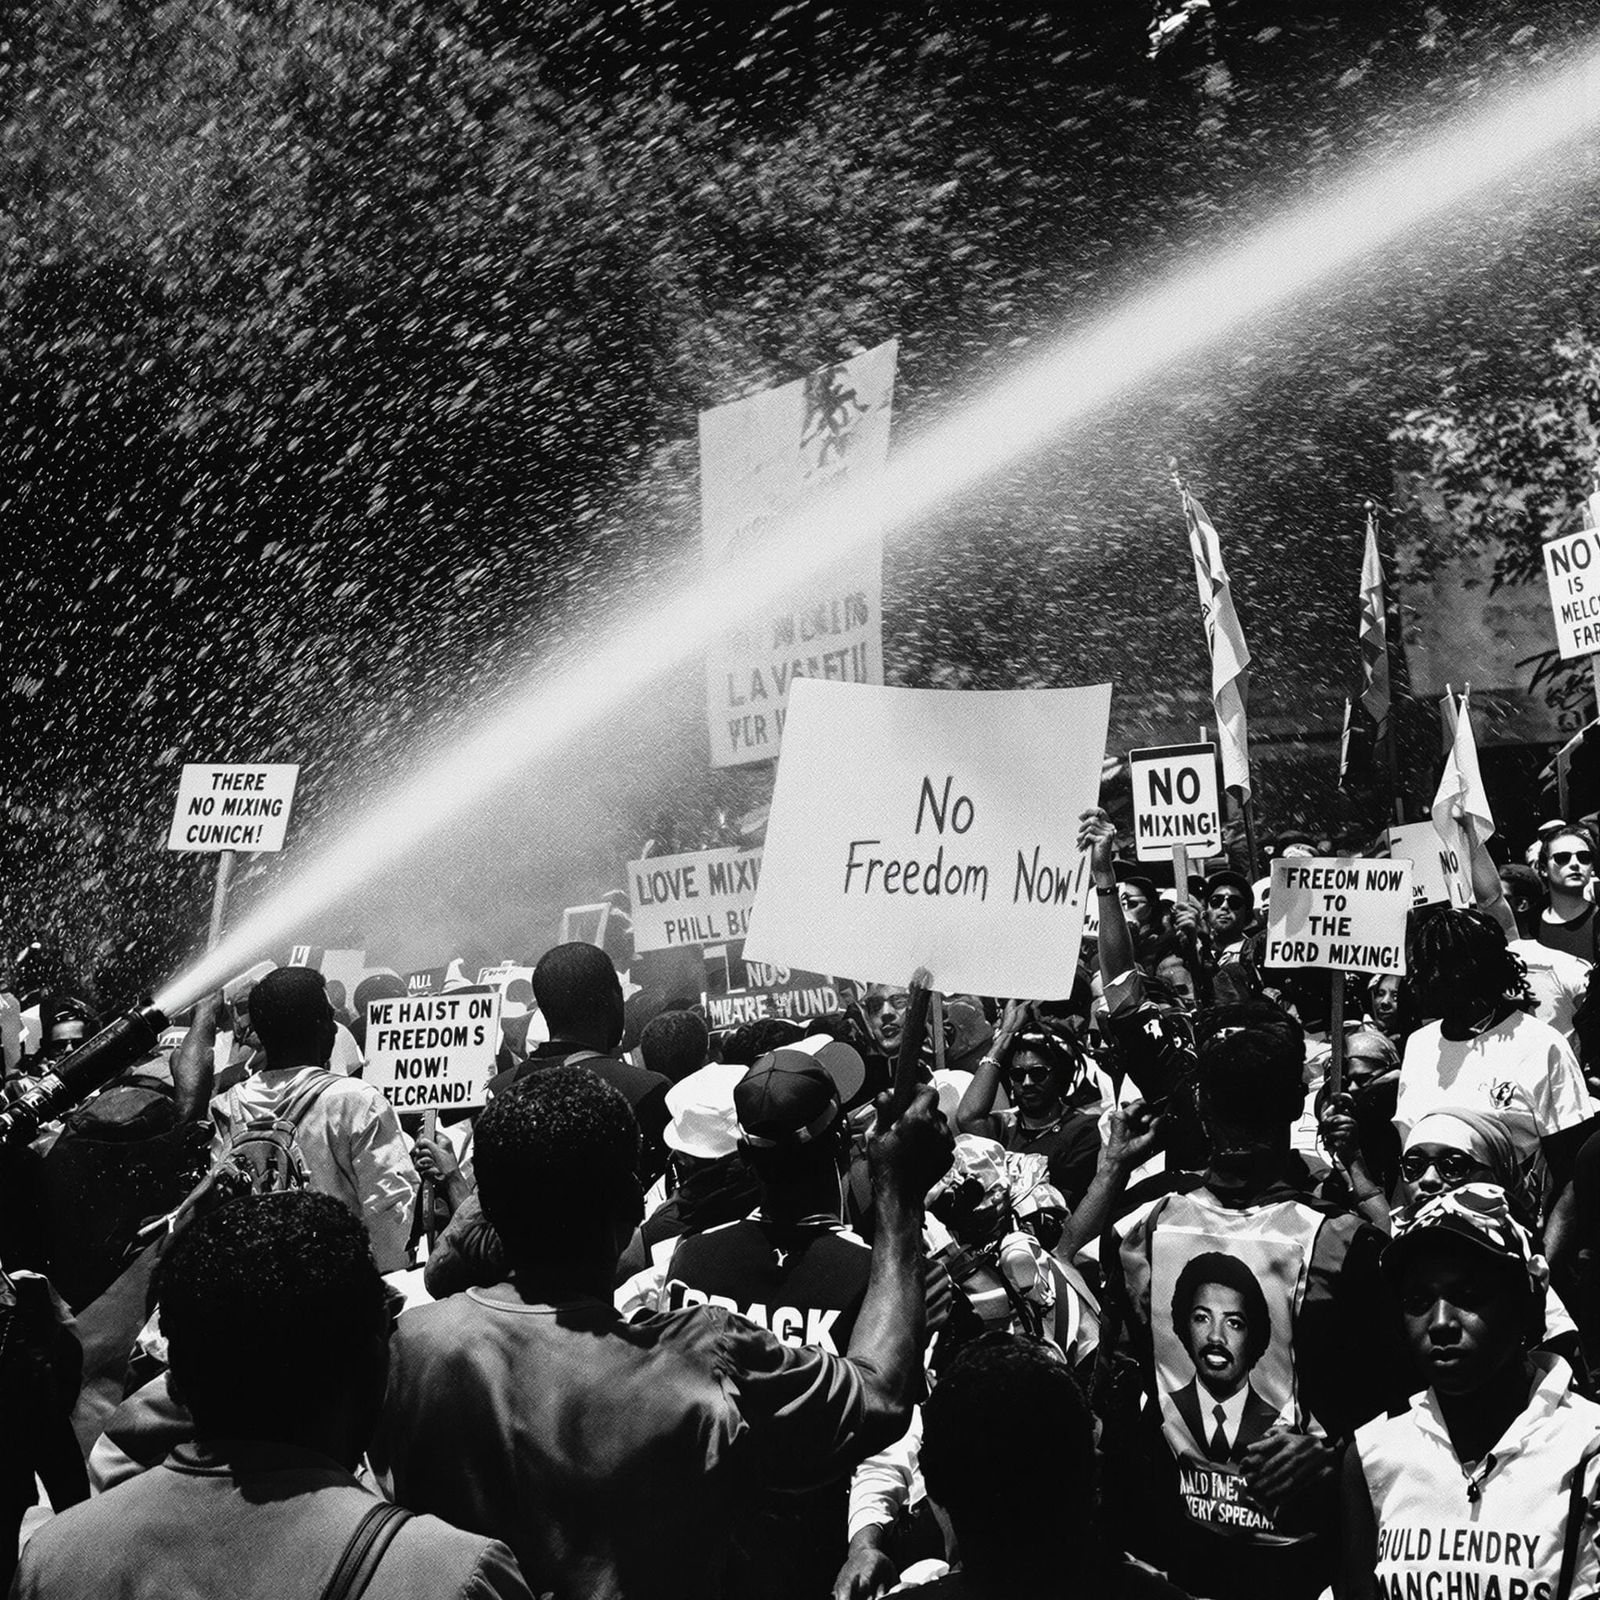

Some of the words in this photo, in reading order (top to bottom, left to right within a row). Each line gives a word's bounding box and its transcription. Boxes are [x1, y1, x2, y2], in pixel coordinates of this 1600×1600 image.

[1550, 538, 1592, 577] NO
[1567, 576, 1584, 596] IS
[1561, 595, 1600, 624] MELC
[211, 772, 268, 791] THERE
[1148, 767, 1200, 806] NO
[187, 796, 215, 817] NO
[221, 797, 283, 817] MIXING
[914, 775, 975, 834] No
[186, 824, 264, 844] CUNICH!
[1139, 812, 1217, 837] MIXING!
[844, 840, 988, 902] Freedom
[1012, 845, 1086, 906] Now!
[1286, 867, 1360, 890] FREEOM
[1365, 869, 1404, 892] NOW
[1323, 894, 1348, 912] TO
[1308, 916, 1352, 937] THE
[1270, 941, 1319, 963] FORD
[1328, 943, 1400, 969] MIXING!
[370, 1004, 393, 1025] WE
[399, 1001, 460, 1024] HAIST
[468, 999, 492, 1019] ON
[394, 1056, 449, 1080] NOW!
[1438, 1528, 1541, 1569] LENDRY
